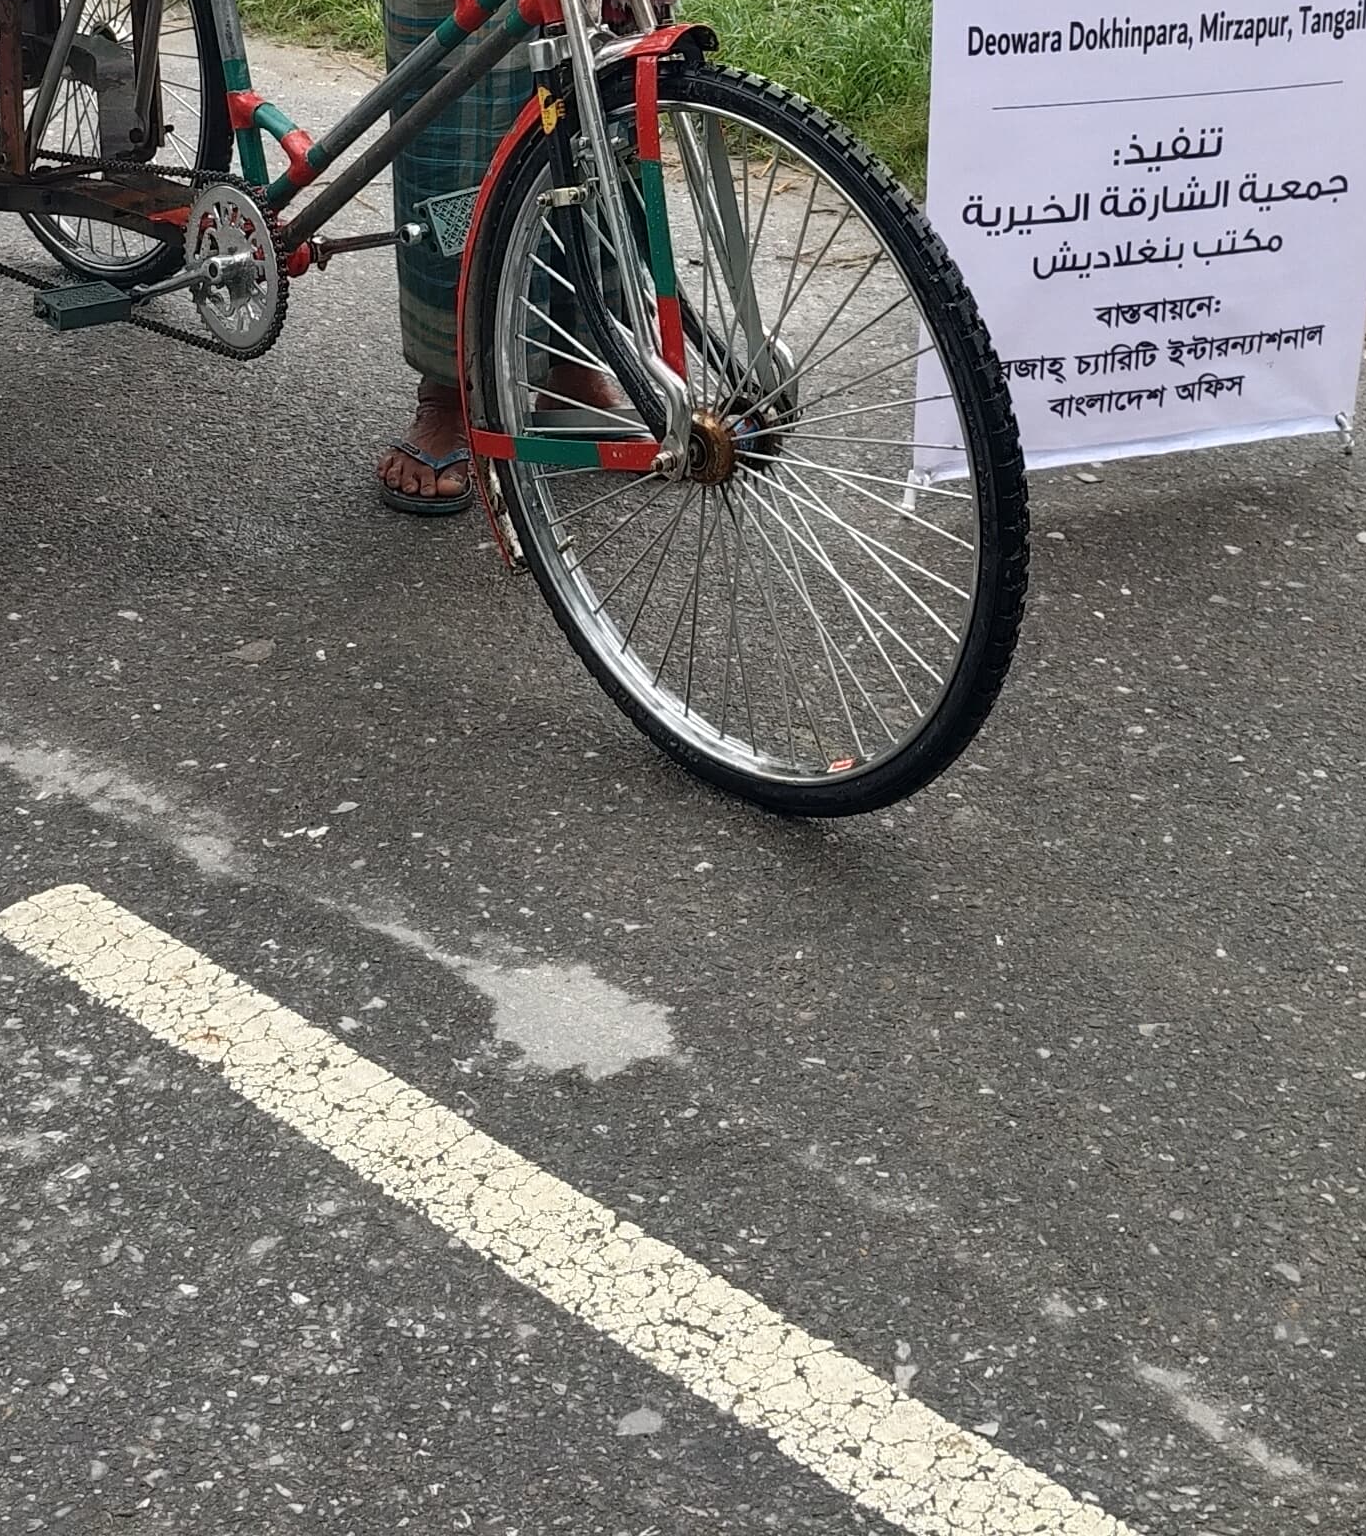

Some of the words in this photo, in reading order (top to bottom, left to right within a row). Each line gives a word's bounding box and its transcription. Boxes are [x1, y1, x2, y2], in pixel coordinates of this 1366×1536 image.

[967, 26, 1062, 57] Deowara
[1069, 16, 1193, 55] Dokhinpara,
[1199, 10, 1293, 47] Mirzapur,
[1113, 126, 1223, 173] تنفيذ:
[962, 192, 1090, 237] الخيرية
[1099, 175, 1230, 222] الشارقة
[1238, 172, 1348, 212] جمعية
[1033, 236, 1185, 281] بنغلاديش
[1193, 227, 1283, 264] مكتب
[1093, 295, 1221, 329] বাস্তবায়নে:
[999, 354, 1067, 384] রজাহ্
[1073, 340, 1160, 376] চ্যারিটি
[1166, 324, 1326, 368] ইন্টারন্যাশনাল
[1047, 381, 1168, 419] বাংলাদেশ
[1174, 372, 1246, 403] অফিস
